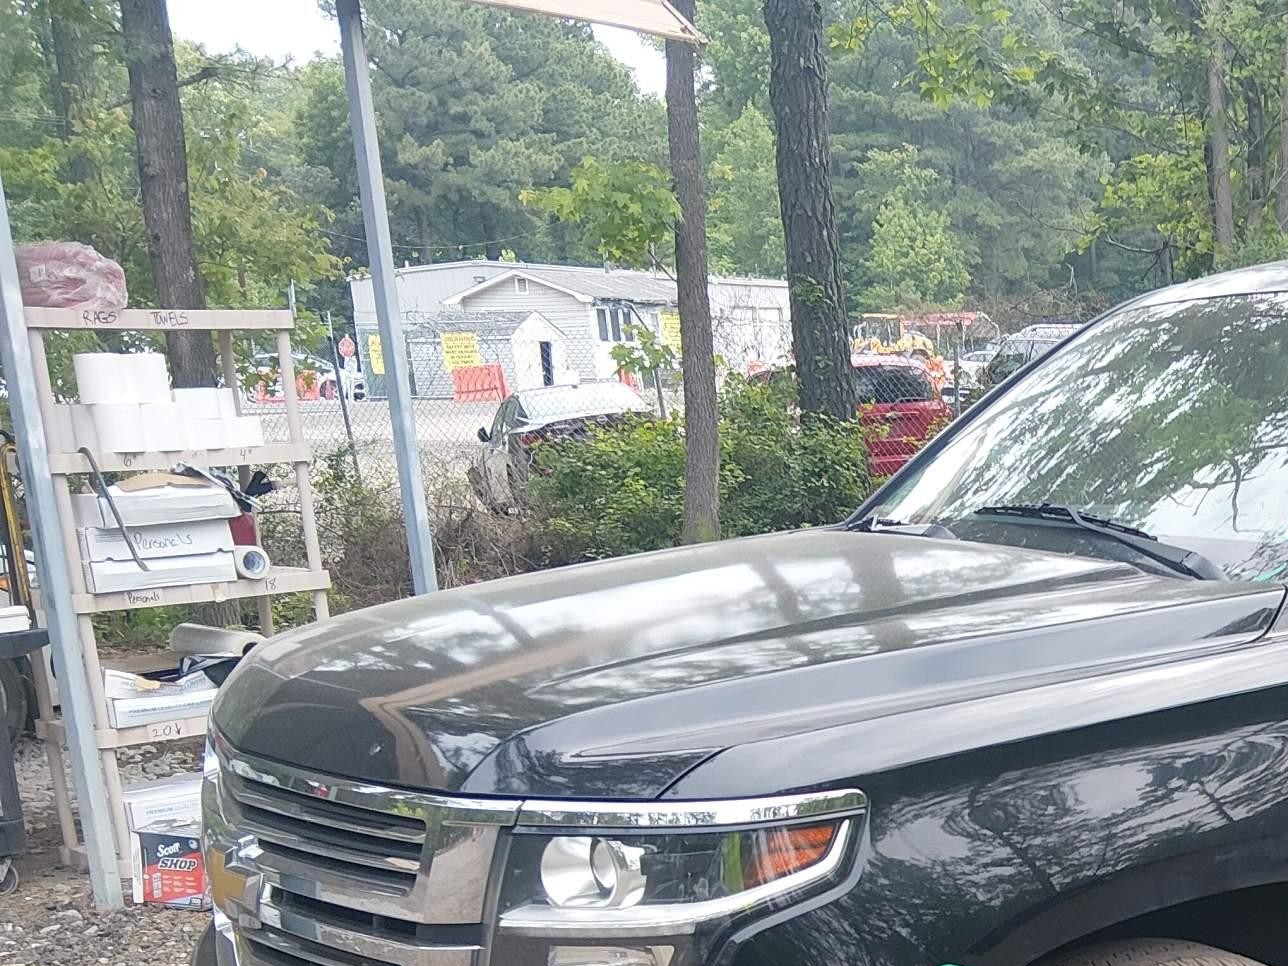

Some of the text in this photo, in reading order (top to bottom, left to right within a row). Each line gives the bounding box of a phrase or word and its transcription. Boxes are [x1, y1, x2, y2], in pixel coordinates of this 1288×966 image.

[82, 310, 118, 325] RAGS
[150, 311, 189, 326] TOWELS
[134, 531, 193, 551] Personals
[156, 842, 181, 858] Scott
[159, 858, 197, 871] SHOP
